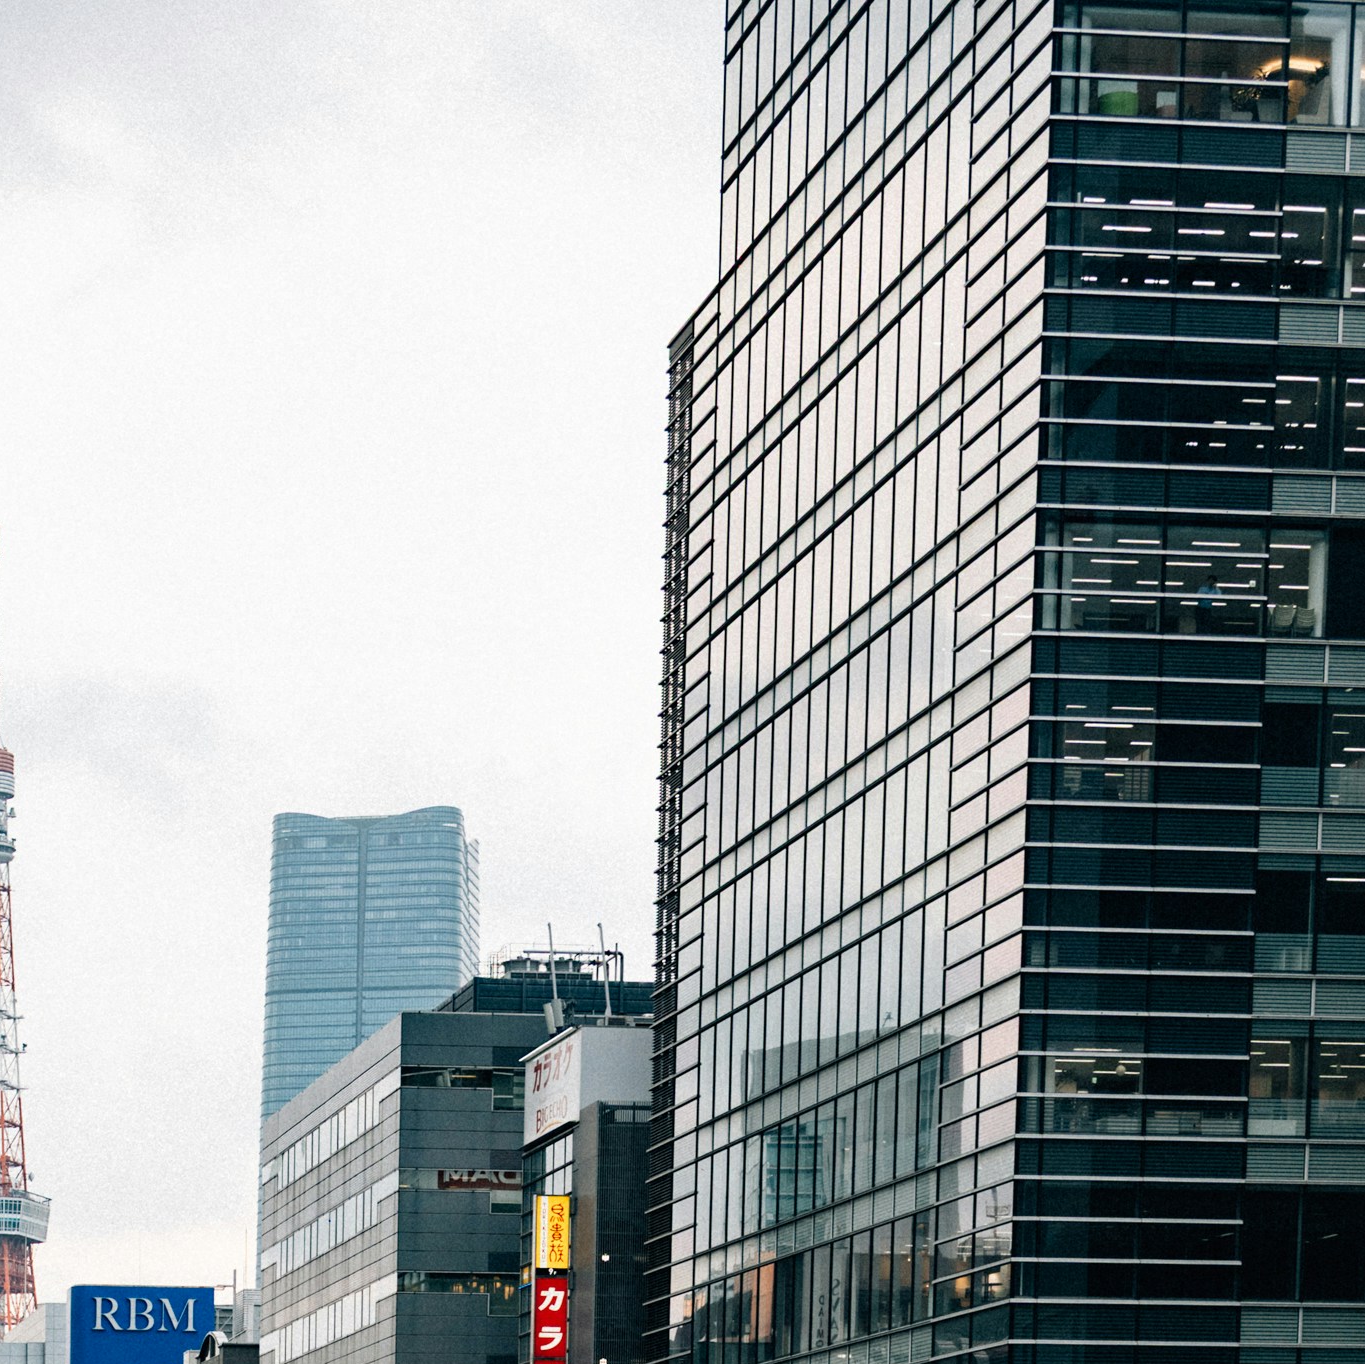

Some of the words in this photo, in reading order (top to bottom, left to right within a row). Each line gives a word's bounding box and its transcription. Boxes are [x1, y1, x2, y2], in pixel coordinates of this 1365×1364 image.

[532, 1041, 574, 1094] カラオケ
[548, 1203, 564, 1263] 鳥貴族
[92, 1296, 197, 1332] RBM
